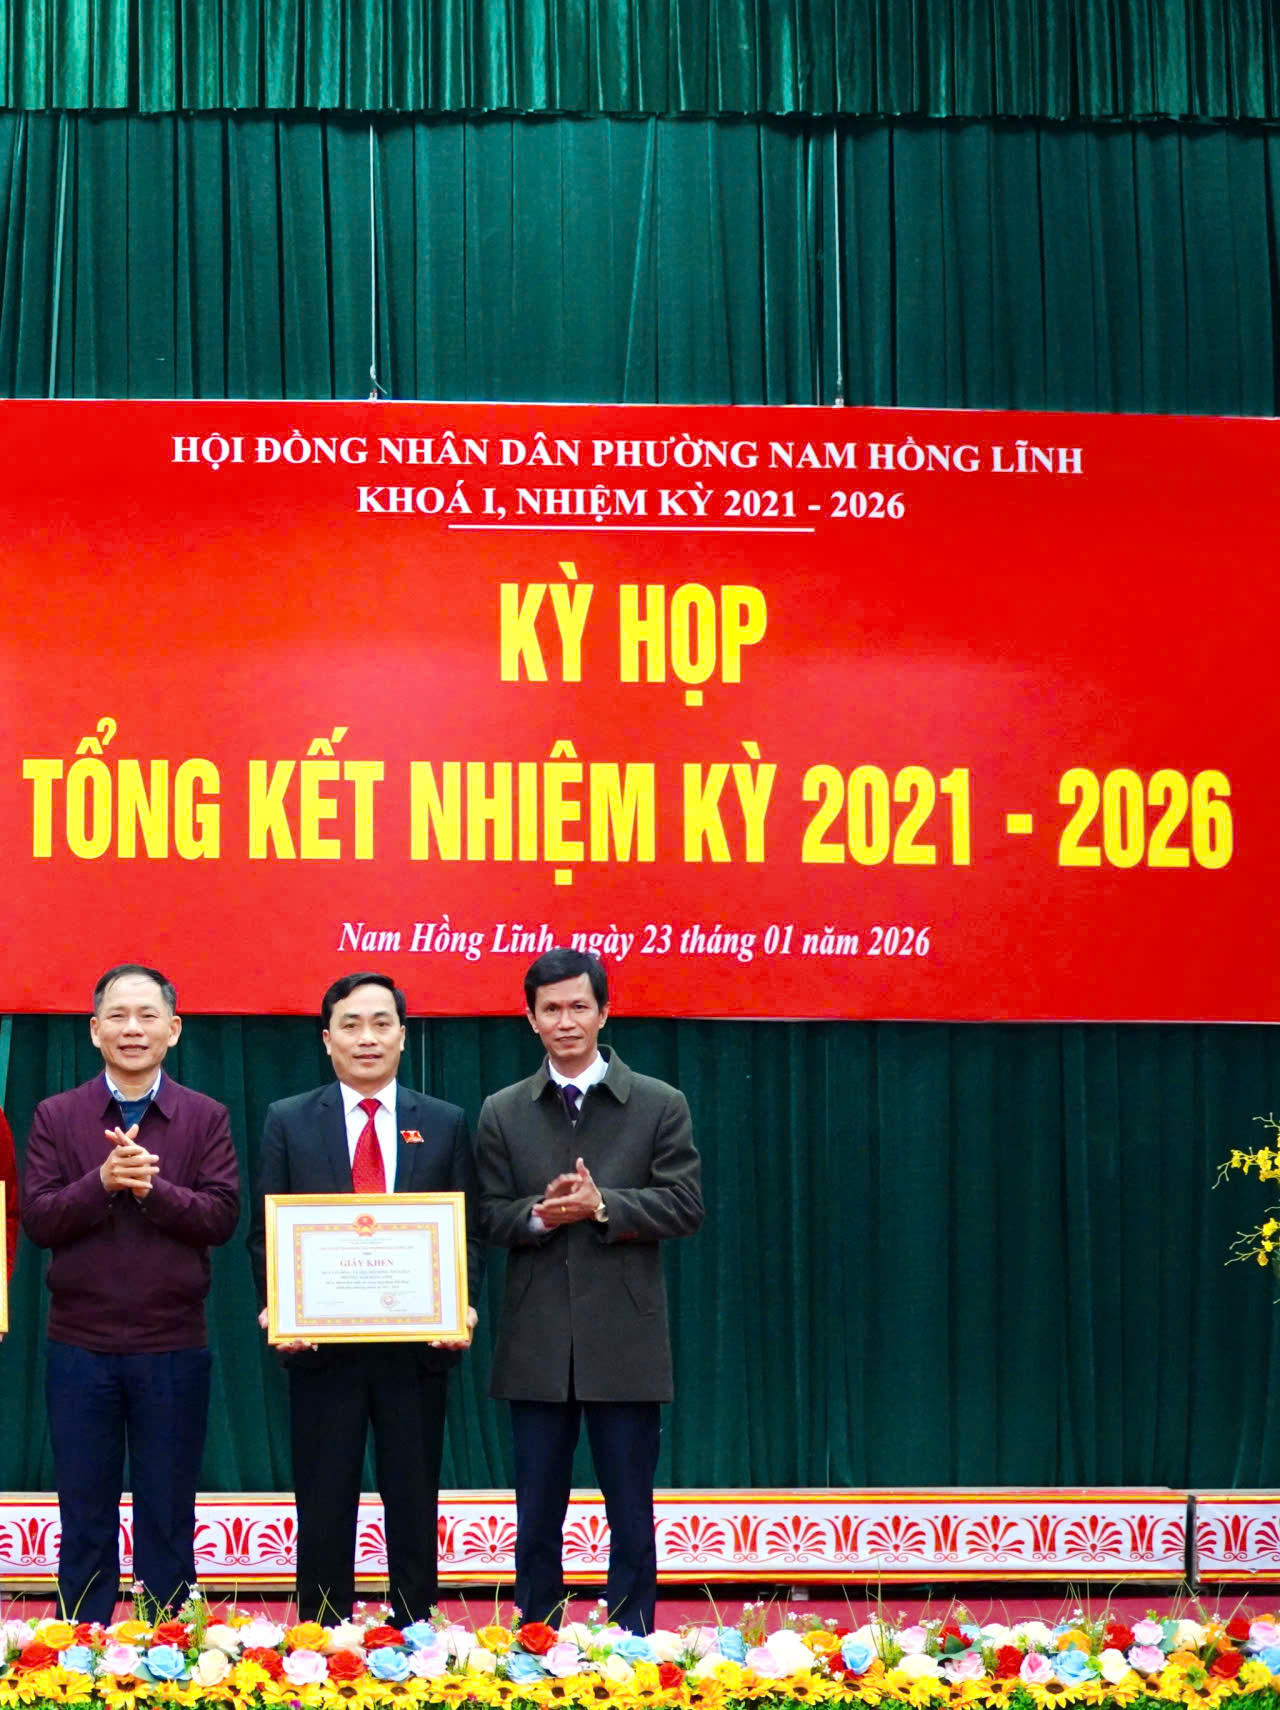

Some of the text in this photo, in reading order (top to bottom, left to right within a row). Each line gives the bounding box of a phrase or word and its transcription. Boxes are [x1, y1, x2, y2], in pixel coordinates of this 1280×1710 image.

[172, 429, 1082, 474] HỘI ĐỒNG NHÂN DÂN PHƯỜNG NAM HỒNG LĨNH
[357, 479, 473, 514] KHOÁ
[482, 487, 507, 520] I,
[516, 484, 648, 523] NHIỆM
[659, 479, 713, 516] KỲ
[724, 489, 796, 518] 2021
[831, 490, 904, 520] 2026
[500, 561, 767, 707] KỲ HỌP
[22, 716, 1233, 886] TỔNG KẾT NHIỆM KỲ 2021 - 2026
[337, 922, 401, 952] Nam
[408, 914, 484, 961] Hồng
[571, 924, 634, 962] ngày
[641, 924, 672, 954] 23
[680, 924, 756, 963] tháng
[764, 924, 793, 955] 01
[802, 925, 858, 956] năm
[867, 926, 931, 957] 2026
[366, 1258, 394, 1267] KHEN
